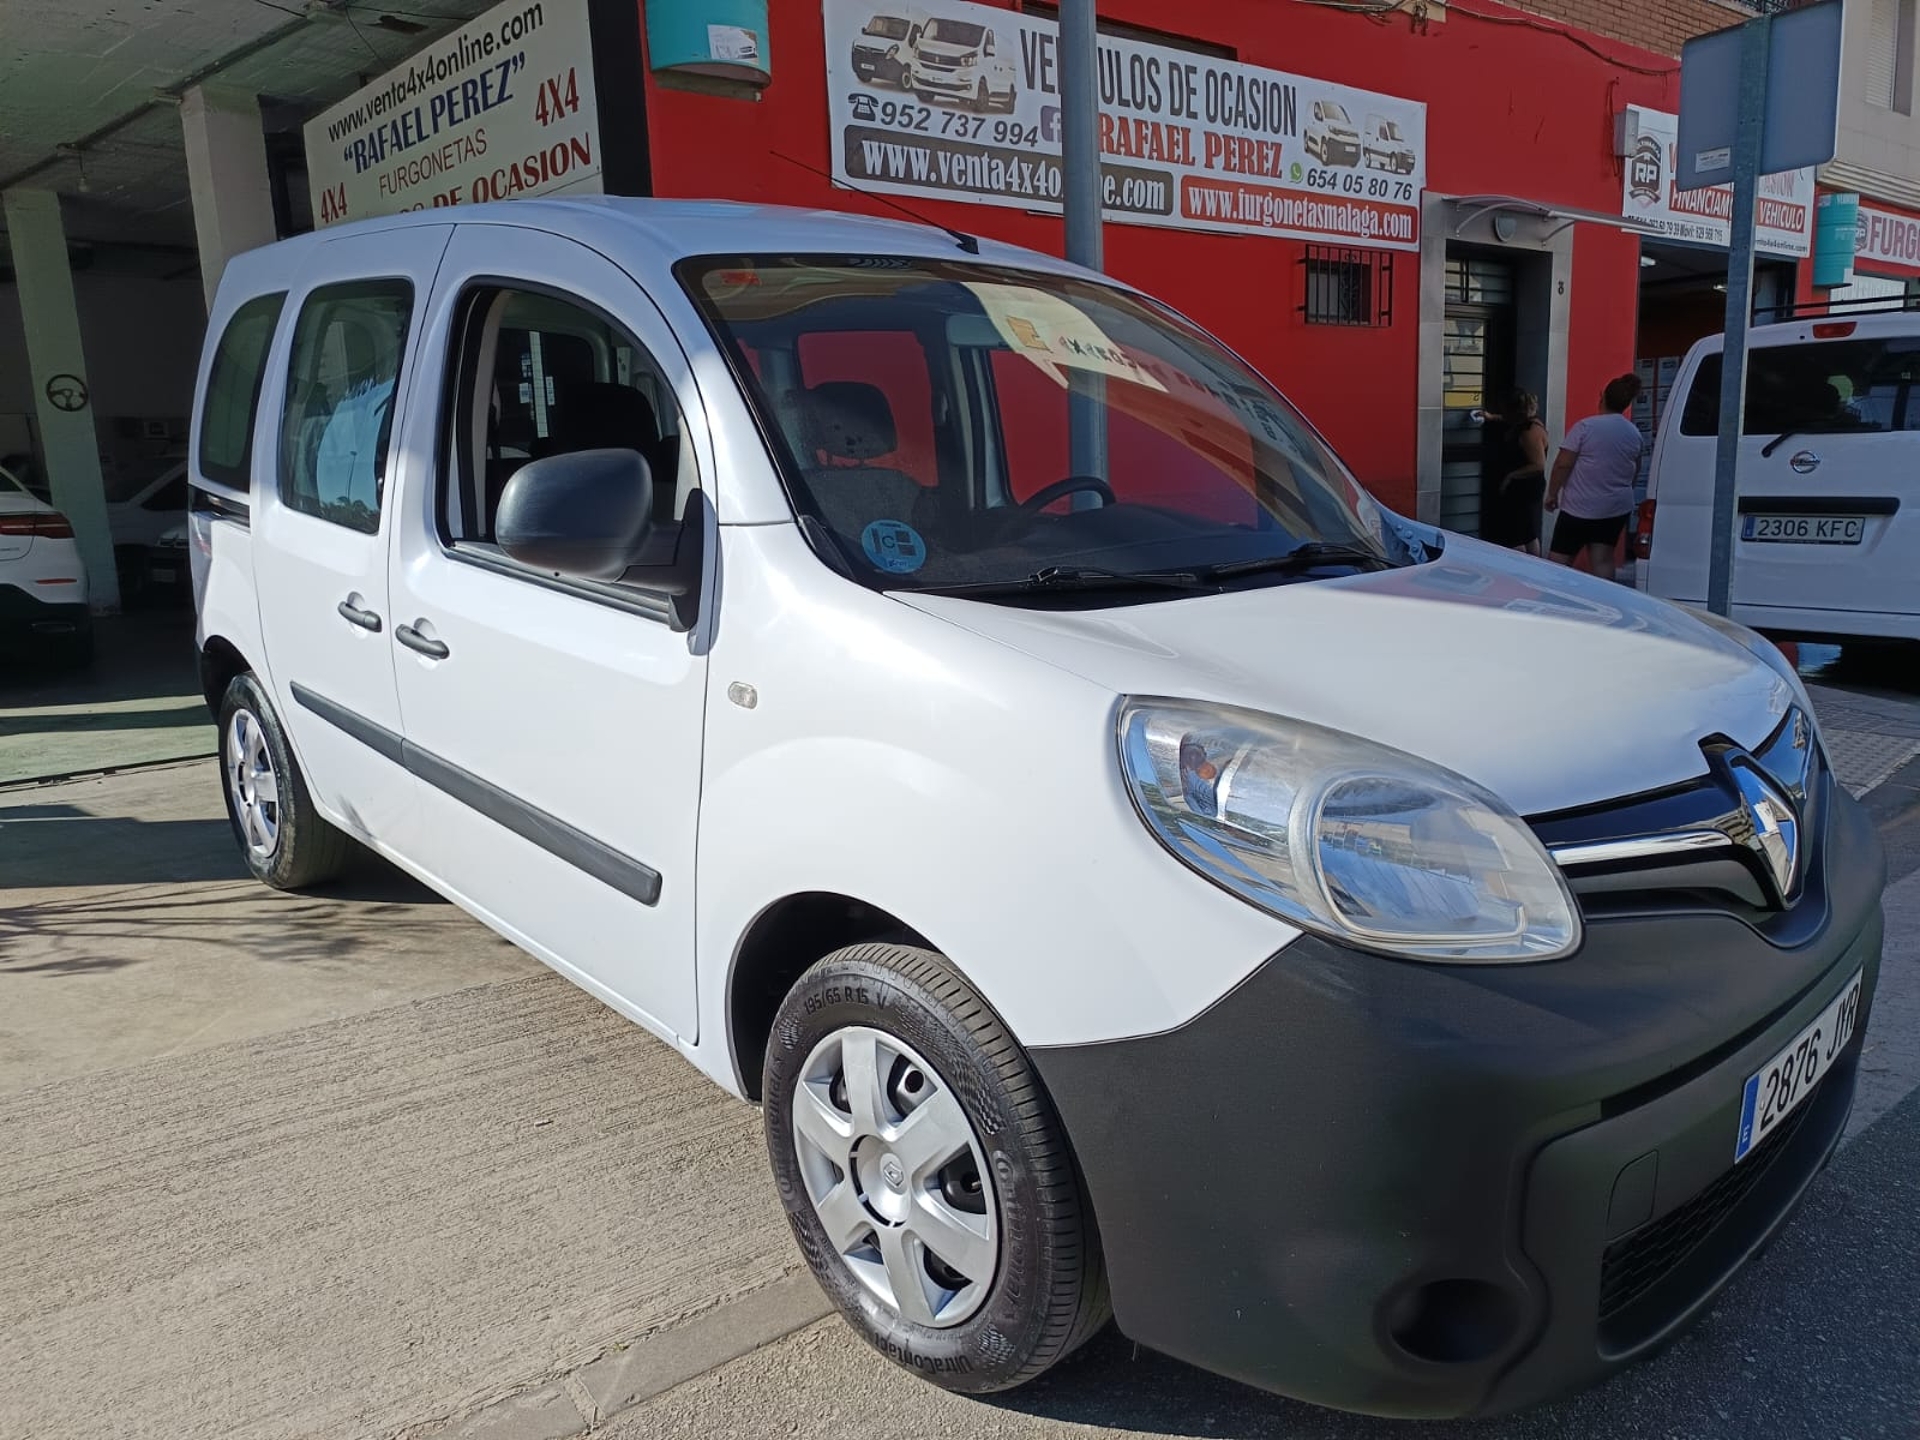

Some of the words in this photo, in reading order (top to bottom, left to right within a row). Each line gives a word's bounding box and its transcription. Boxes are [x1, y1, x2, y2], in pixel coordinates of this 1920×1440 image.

[328, 2, 544, 143] www.venta4x4online.com
[535, 67, 580, 127] 4X4
[1020, 28, 1162, 113] VEULOS
[1168, 61, 1199, 121] DE
[1205, 68, 1297, 138] OCASION
[880, 101, 932, 132] 952
[941, 111, 986, 139] 737
[992, 120, 1039, 148] 994
[1100, 112, 1196, 166] RAFAEL
[1203, 131, 1284, 179] PEREZ
[379, 128, 488, 199] FURGONETAS
[472, 132, 592, 204] OCASION
[862, 139, 1166, 212] www.venta4x4oe.com
[1307, 168, 1338, 192] 654
[1342, 173, 1364, 195] 05
[1367, 177, 1390, 198] 80
[1393, 181, 1414, 202] 76
[1763, 171, 1797, 199] ASION
[320, 181, 349, 224] 4X4
[1187, 185, 1412, 240] www.furgonetasmalaga.com
[1759, 201, 1804, 232] VEHICULO
[1869, 215, 1920, 262] FURG
[1757, 519, 1809, 537] 2306
[1816, 520, 1857, 538] KFC
[804, 987, 841, 1016] 195/65
[1759, 1028, 1822, 1132] 2876
